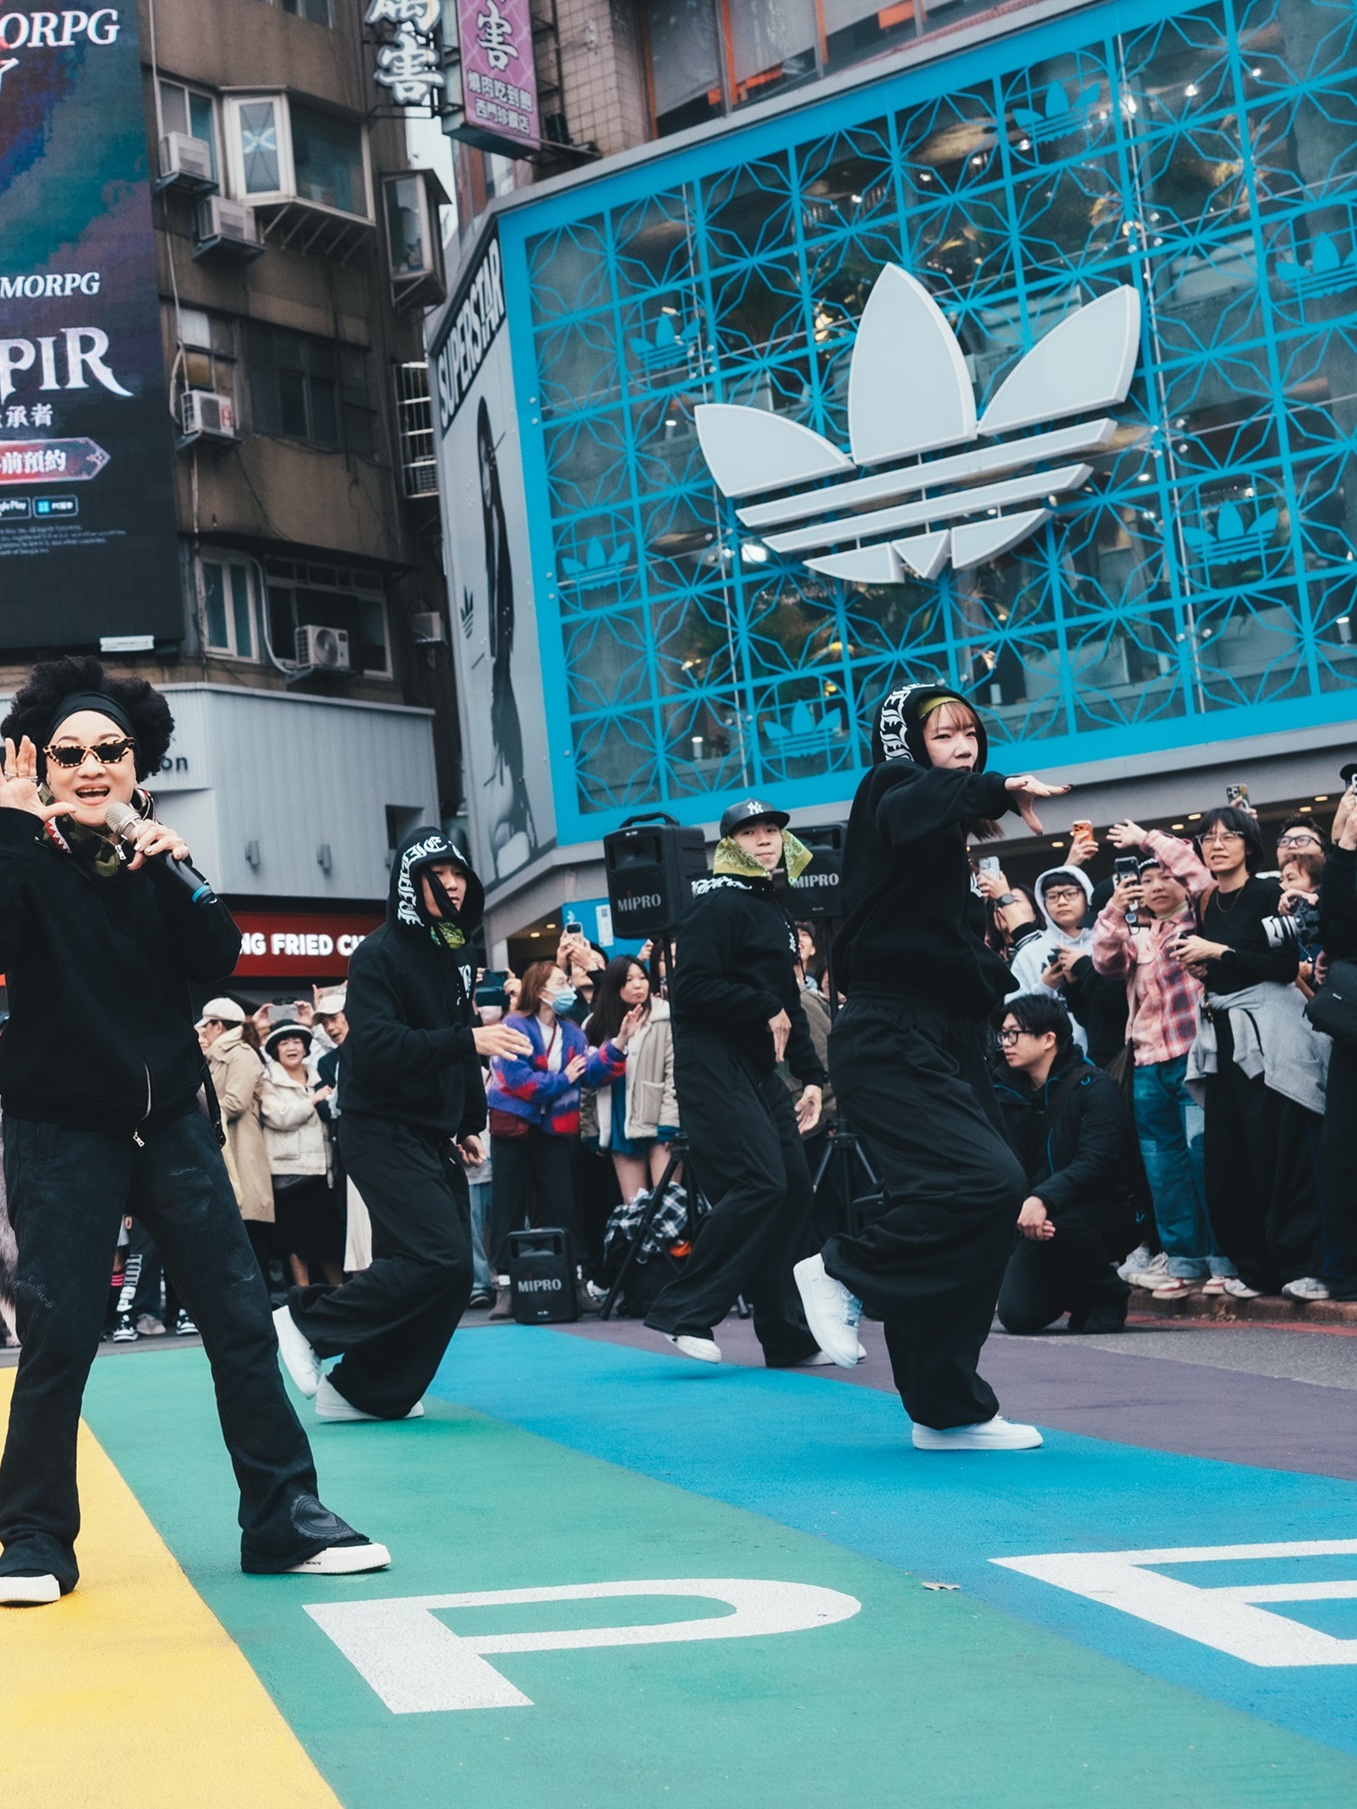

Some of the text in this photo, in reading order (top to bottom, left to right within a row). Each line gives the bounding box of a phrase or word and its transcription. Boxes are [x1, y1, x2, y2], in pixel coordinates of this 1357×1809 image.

[476, 0, 519, 72] 害
[438, 238, 505, 428] SUPERSTAR
[10, 500, 27, 511] Play
[793, 873, 840, 889] MIPRO
[617, 893, 662, 913] MIPRO
[270, 933, 334, 956] FRIED
[517, 1276, 562, 1294] MIPRO
